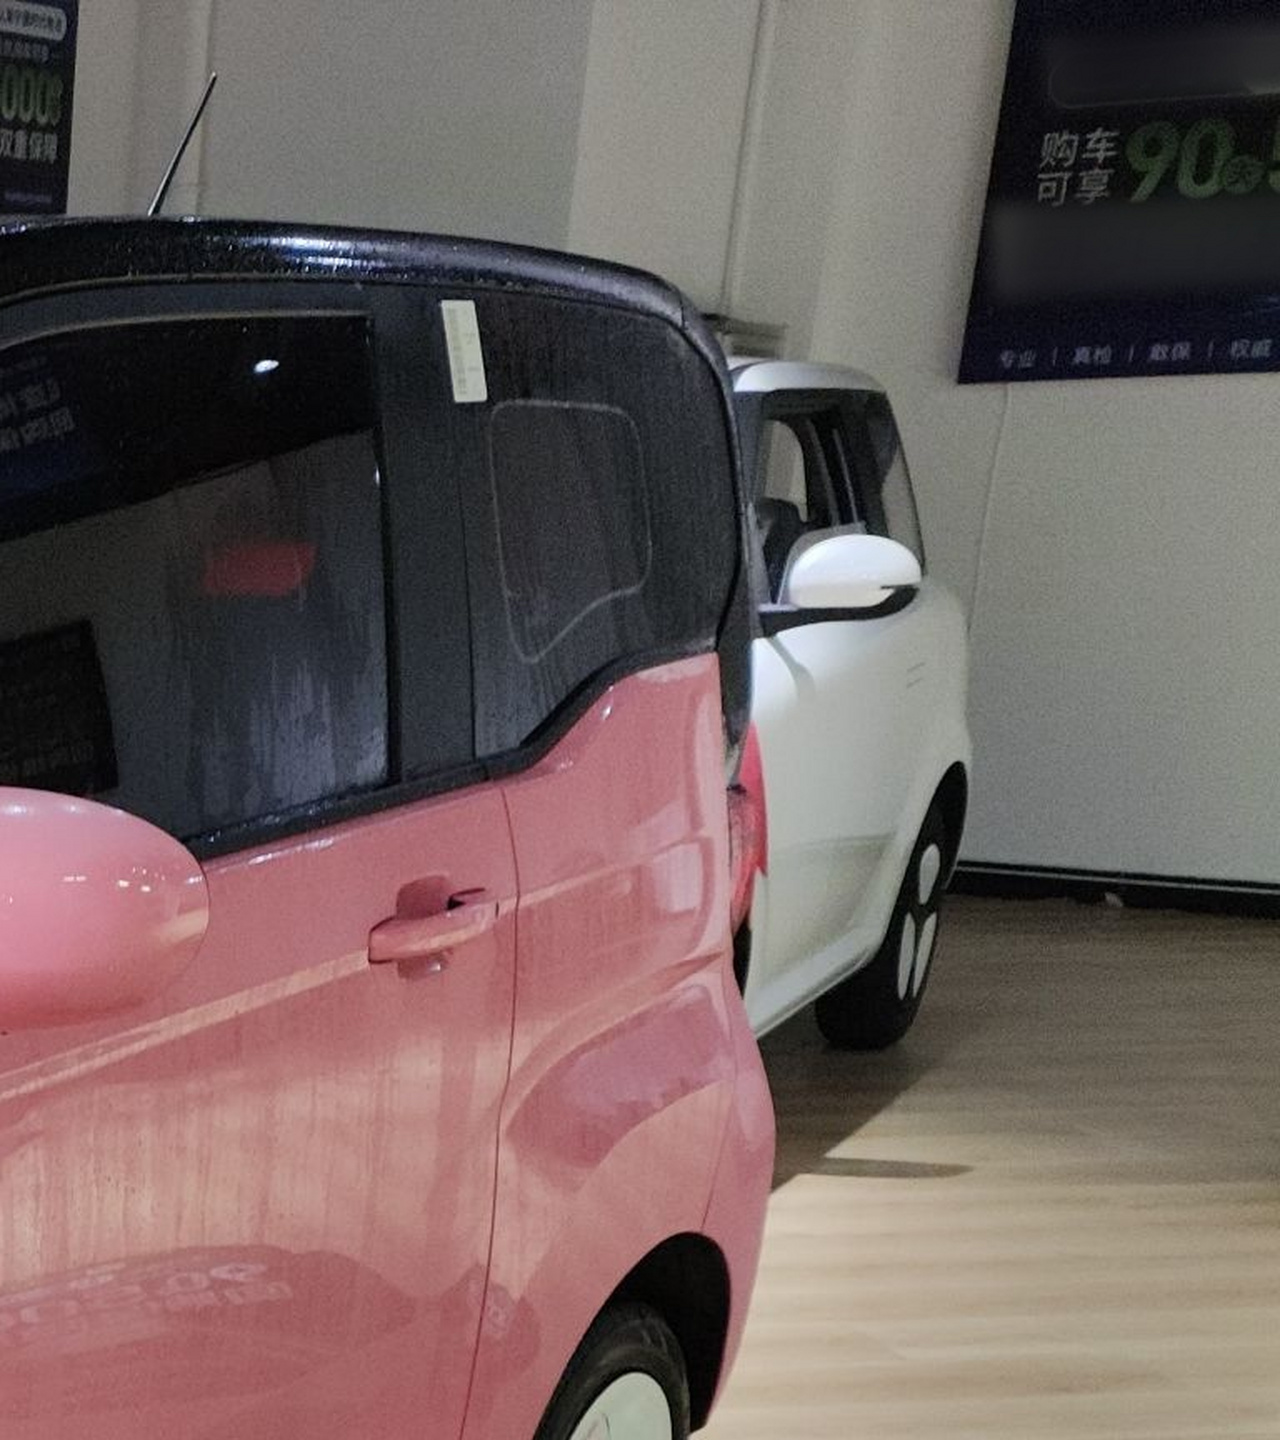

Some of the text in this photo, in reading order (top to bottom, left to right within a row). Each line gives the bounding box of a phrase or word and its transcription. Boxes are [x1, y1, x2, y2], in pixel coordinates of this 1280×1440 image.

[1038, 127, 1121, 168] 购车
[1036, 168, 1115, 207] 可享
[999, 348, 1037, 368] 专业
